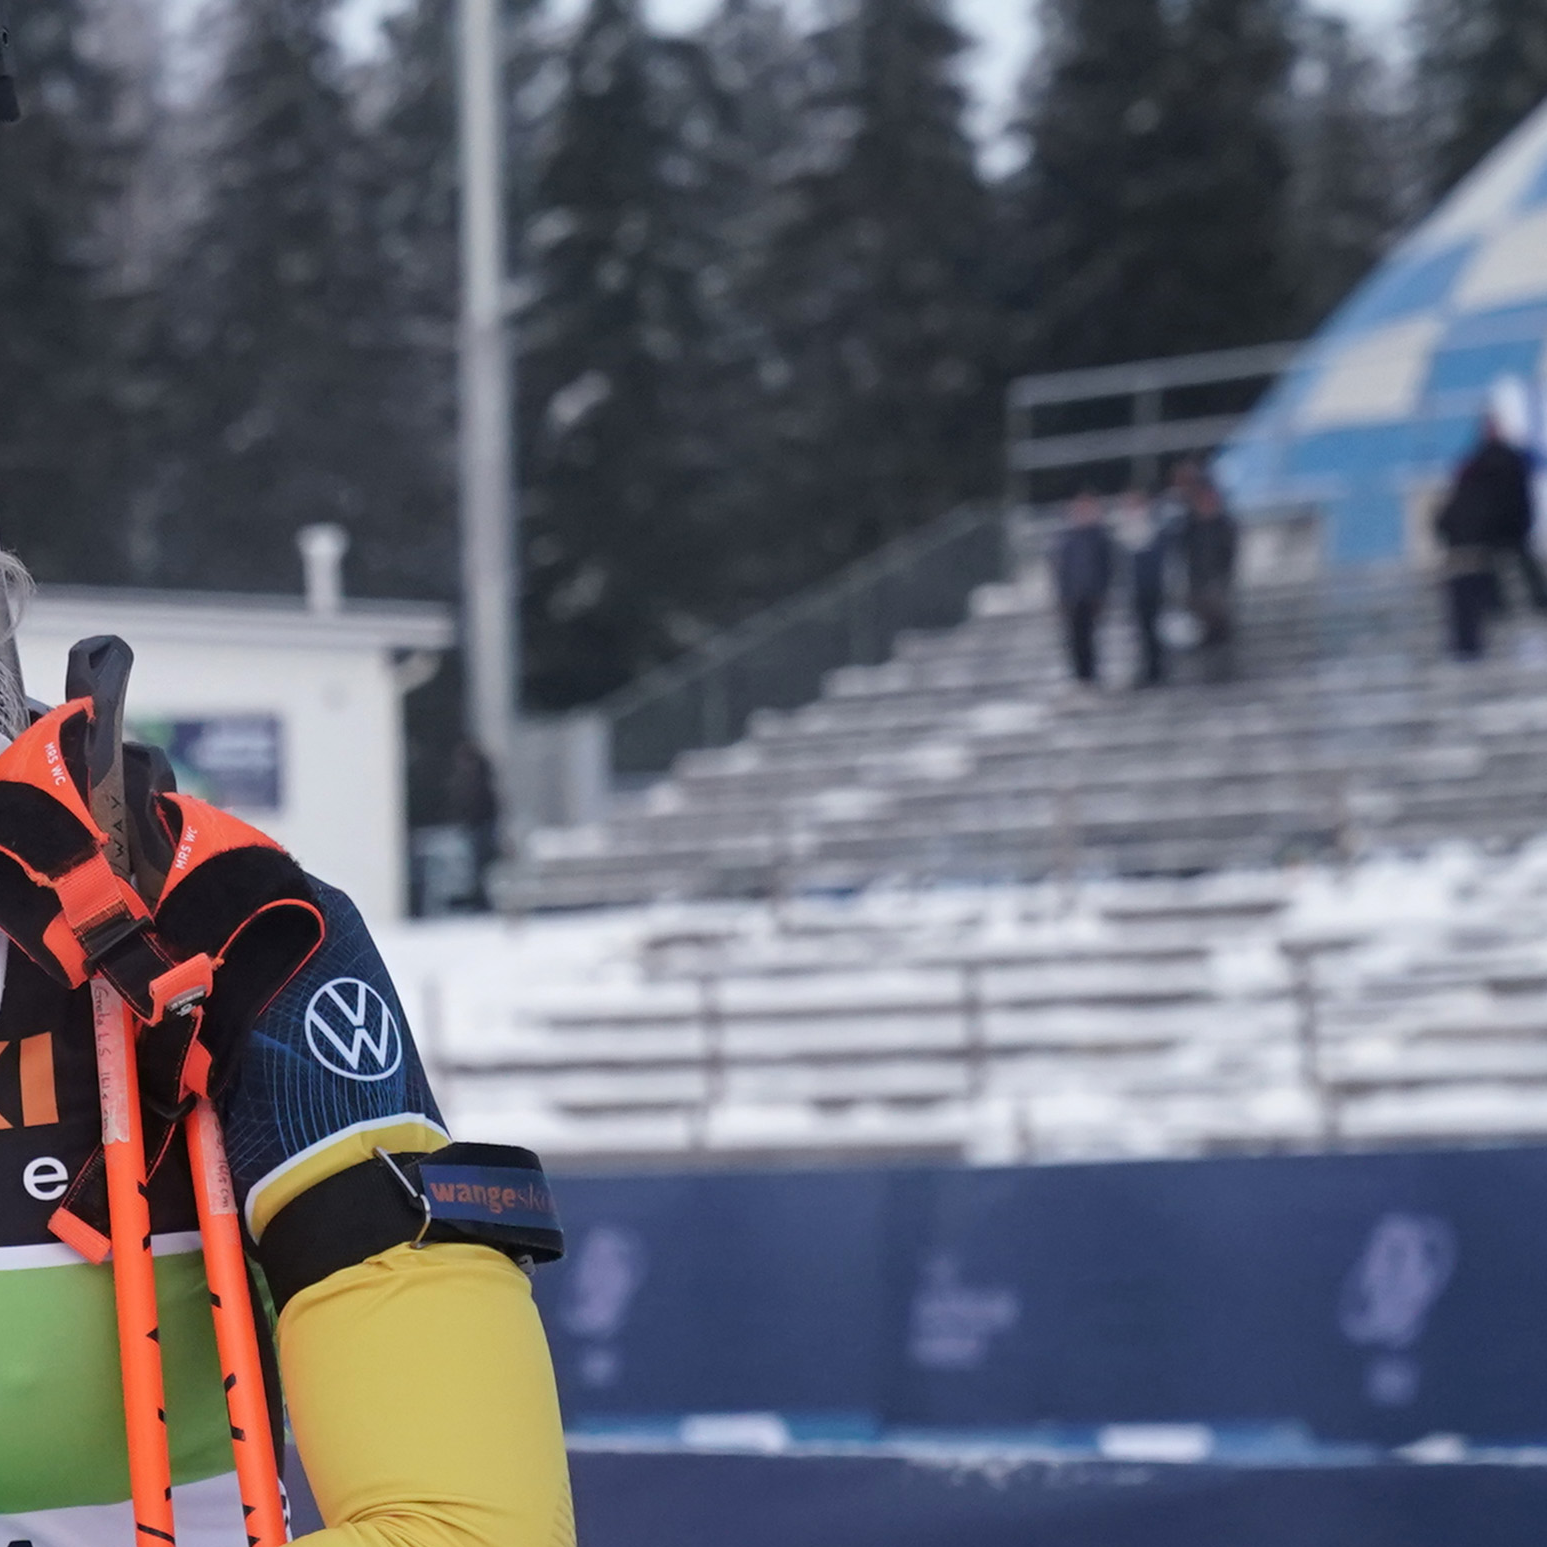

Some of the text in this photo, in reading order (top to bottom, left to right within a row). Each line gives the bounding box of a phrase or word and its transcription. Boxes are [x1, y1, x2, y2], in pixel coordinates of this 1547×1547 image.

[44, 742, 66, 787] MRS WC
[175, 826, 199, 870] MRS WC
